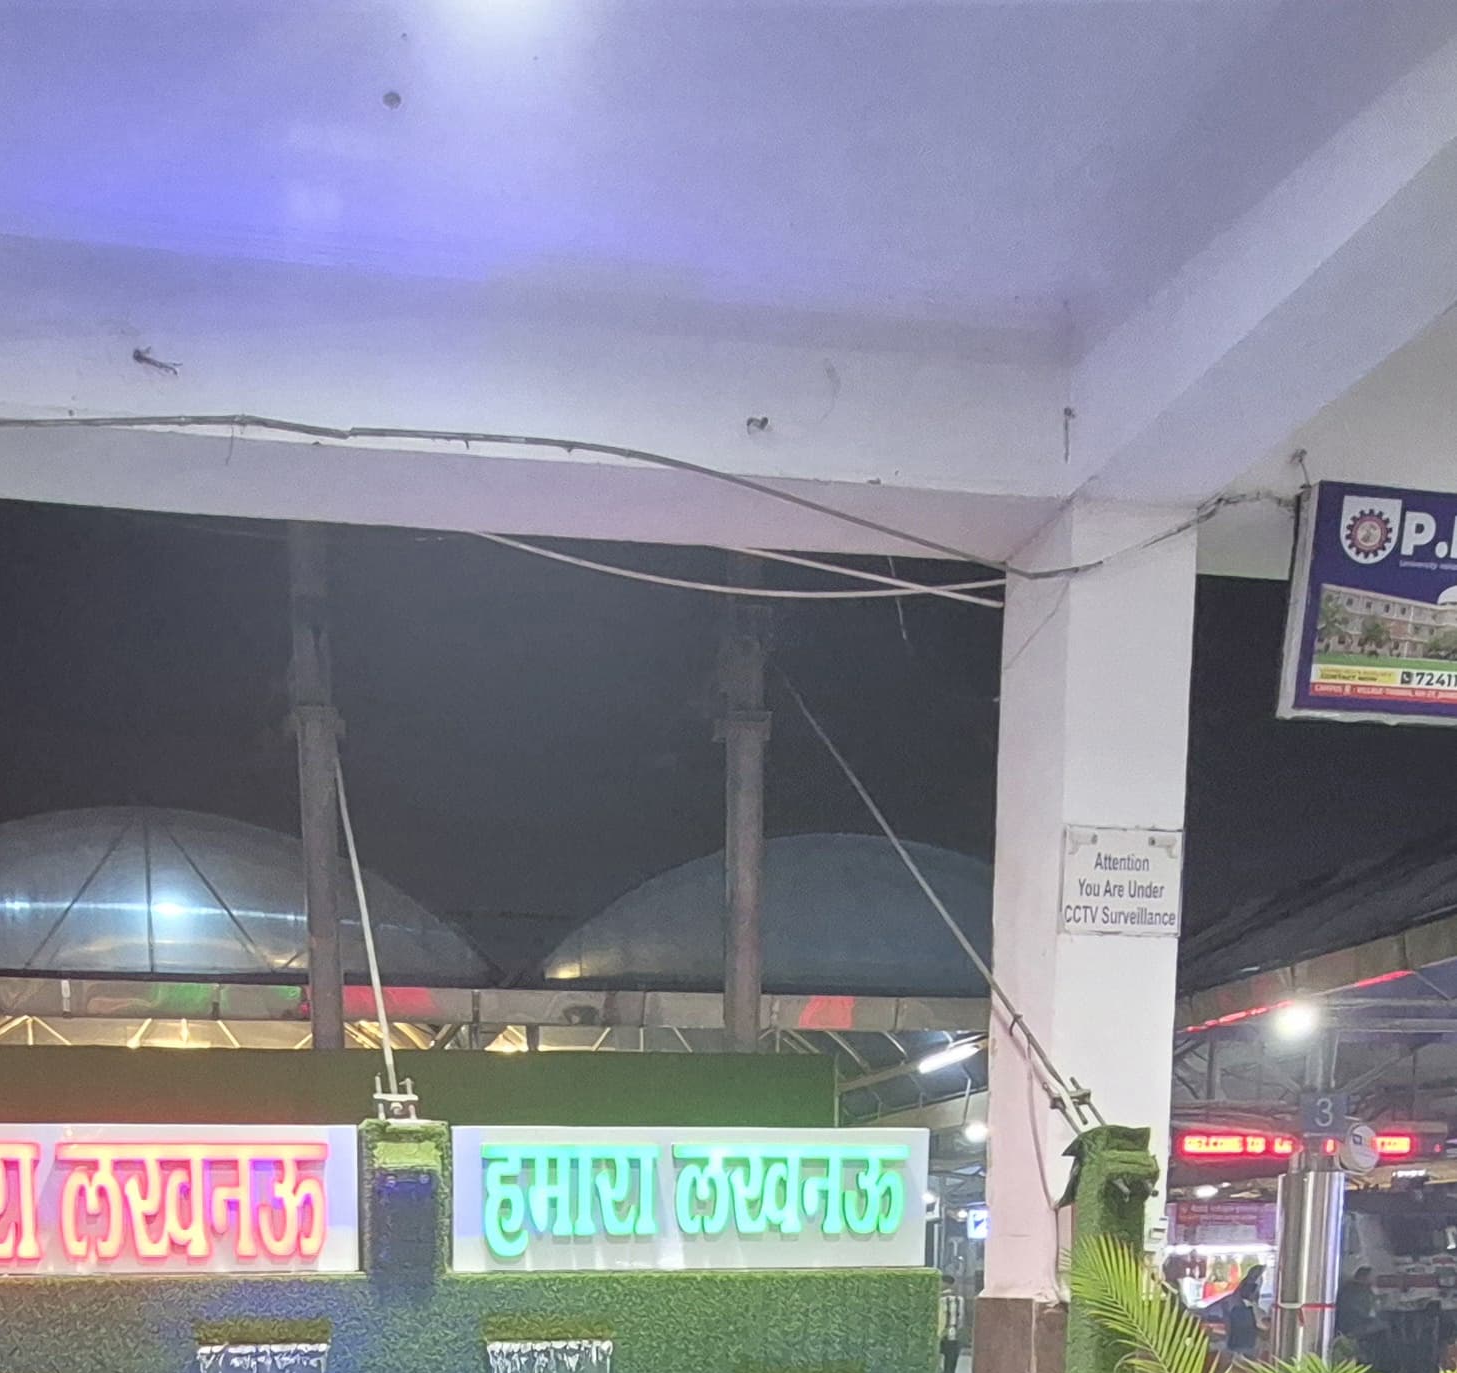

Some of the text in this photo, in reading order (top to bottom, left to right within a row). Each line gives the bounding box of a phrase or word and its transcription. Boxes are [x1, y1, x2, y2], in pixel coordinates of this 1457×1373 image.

[1094, 852, 1150, 872] Attention
[1078, 878, 1165, 899] You Are Under
[1064, 904, 1176, 926] CCTV Surveillance
[1314, 1098, 1334, 1127] 3
[56, 1142, 329, 1260] लखनऊ
[481, 1143, 911, 1258] हमारा लखनऊ
